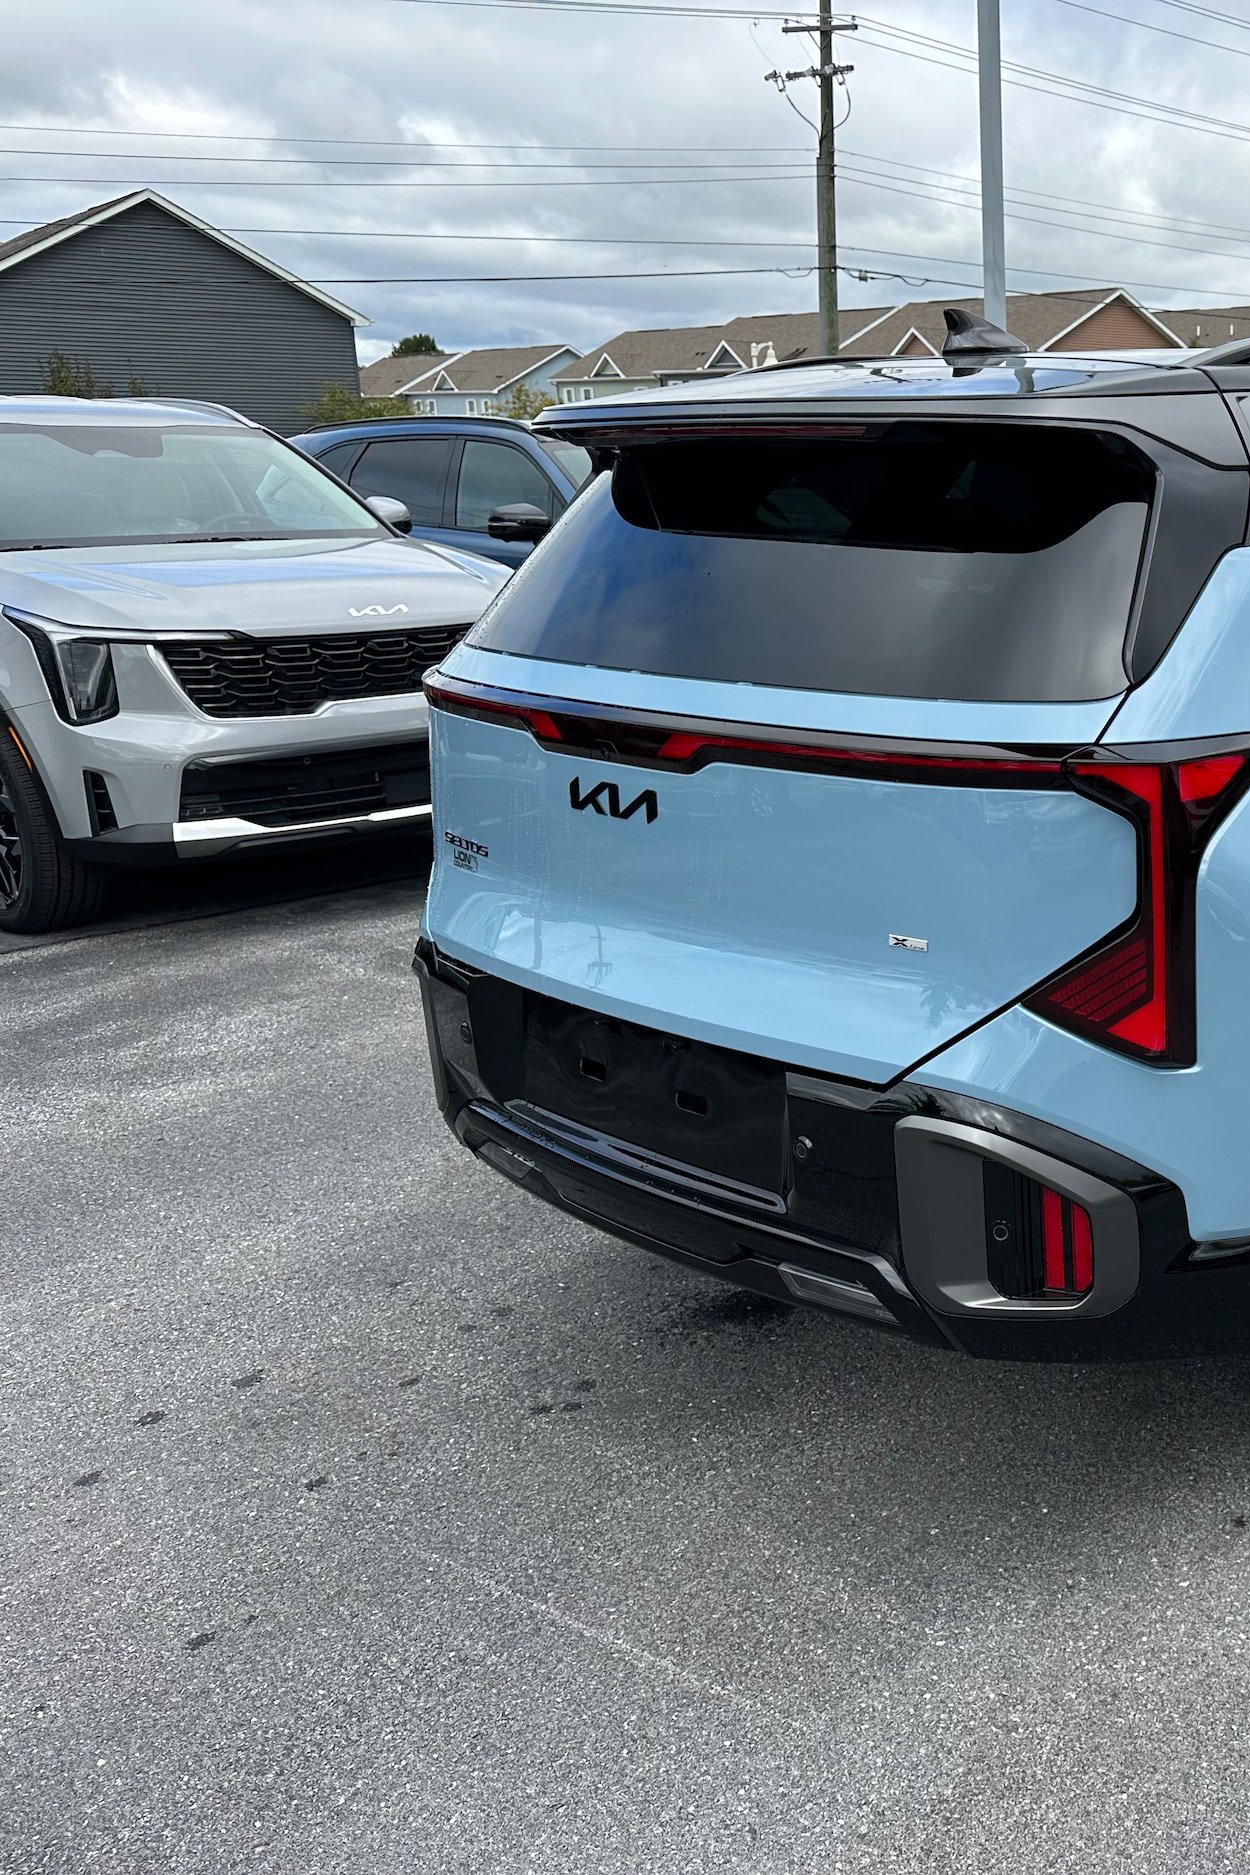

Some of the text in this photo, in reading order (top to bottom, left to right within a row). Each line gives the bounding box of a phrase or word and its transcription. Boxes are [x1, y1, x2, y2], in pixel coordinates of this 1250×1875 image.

[347, 603, 410, 617] KIA
[569, 776, 658, 824] KIA
[445, 831, 489, 858] SELTOS
